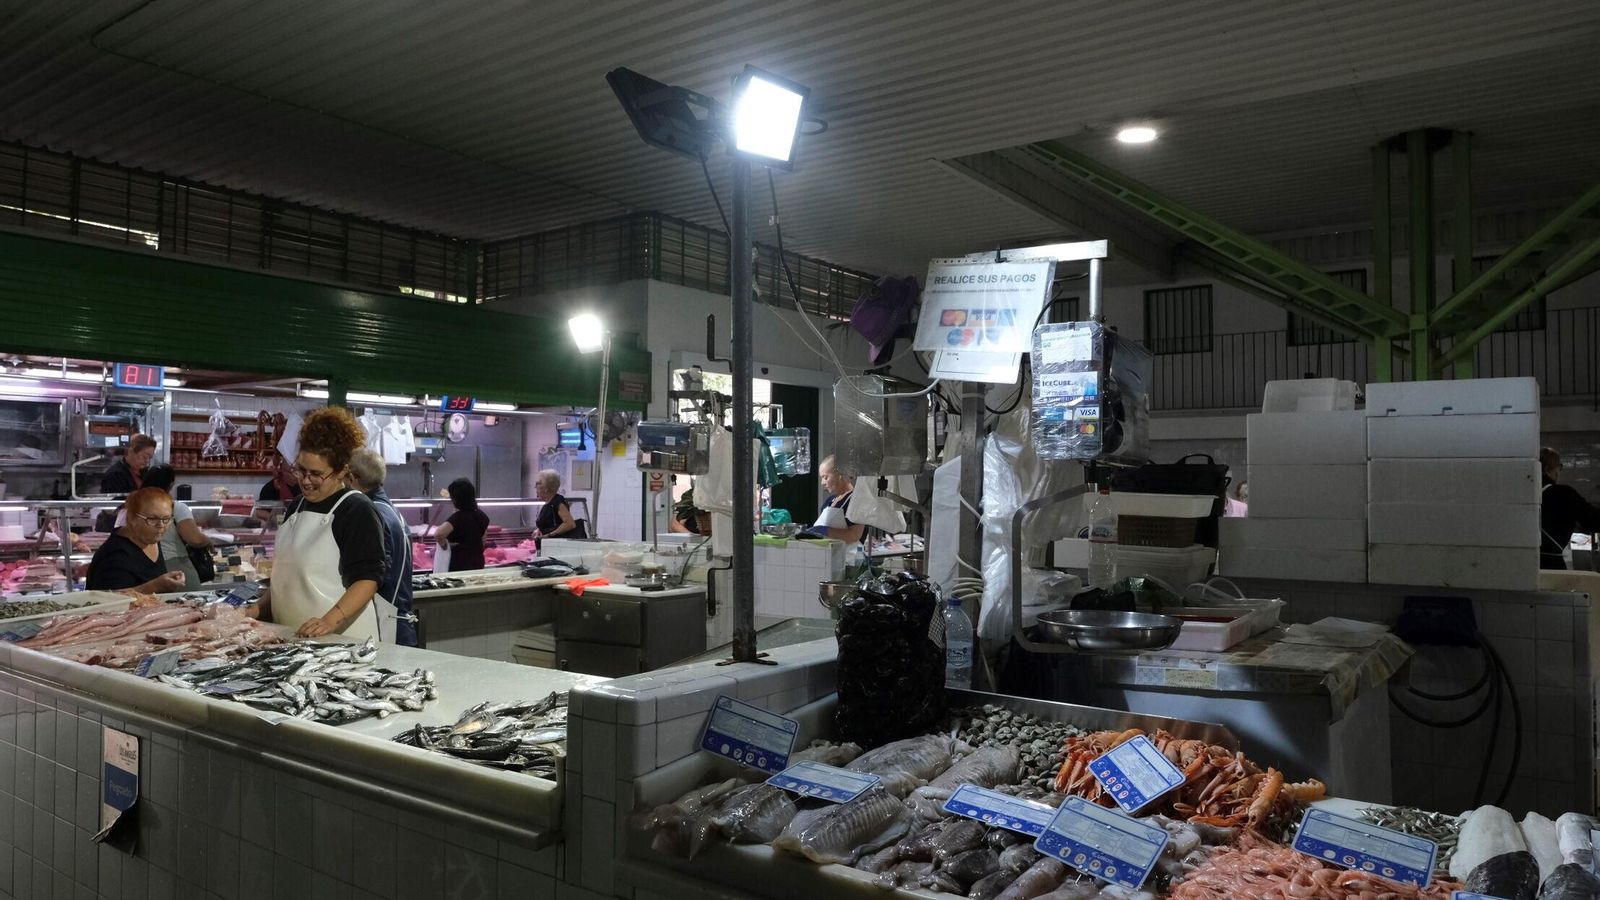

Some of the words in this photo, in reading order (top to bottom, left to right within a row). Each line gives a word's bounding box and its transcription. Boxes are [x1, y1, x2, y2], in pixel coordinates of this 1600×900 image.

[934, 275, 976, 285] REALICE
[977, 275, 998, 284] SUS
[1000, 273, 1037, 283] PAGOS
[125, 365, 153, 386] 81
[449, 397, 469, 410] 33
